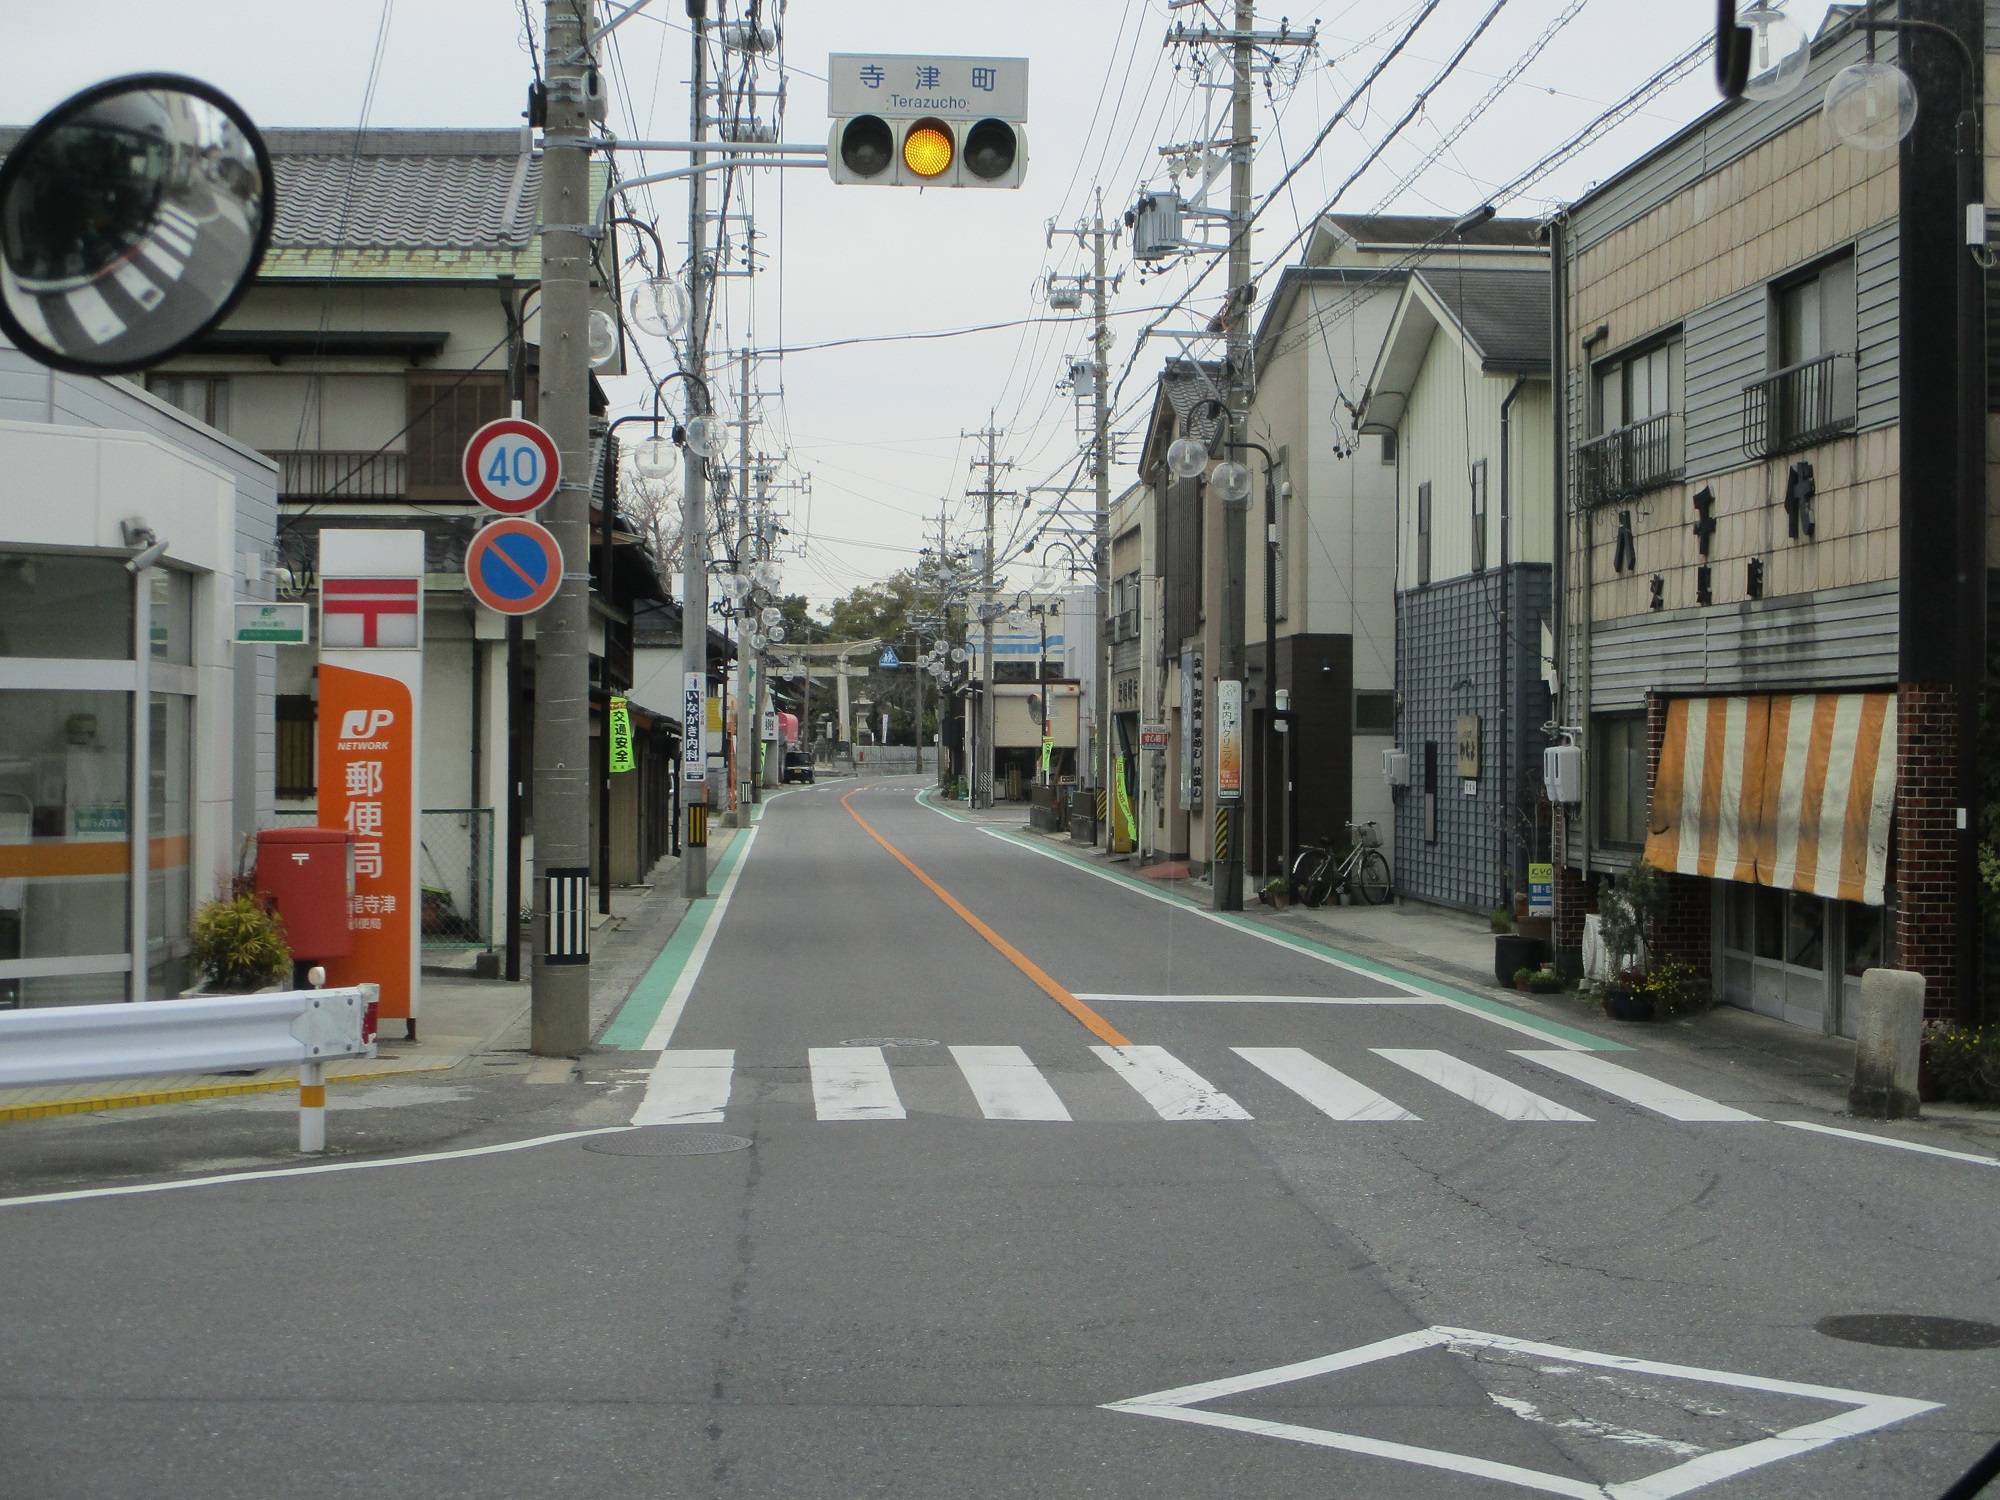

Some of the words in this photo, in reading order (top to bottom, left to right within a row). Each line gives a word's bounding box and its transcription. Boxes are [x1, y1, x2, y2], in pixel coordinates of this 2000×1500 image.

[860, 64, 996, 91] 寺津町
[891, 94, 967, 109] Terazucho
[487, 446, 537, 486] 40
[339, 709, 394, 738] JP
[612, 711, 629, 762] 交通安全
[686, 691, 699, 760] いながき内科
[1222, 701, 1232, 768] 森内科クリニック
[337, 741, 389, 750] NETWORK
[344, 761, 383, 878] 郵便局
